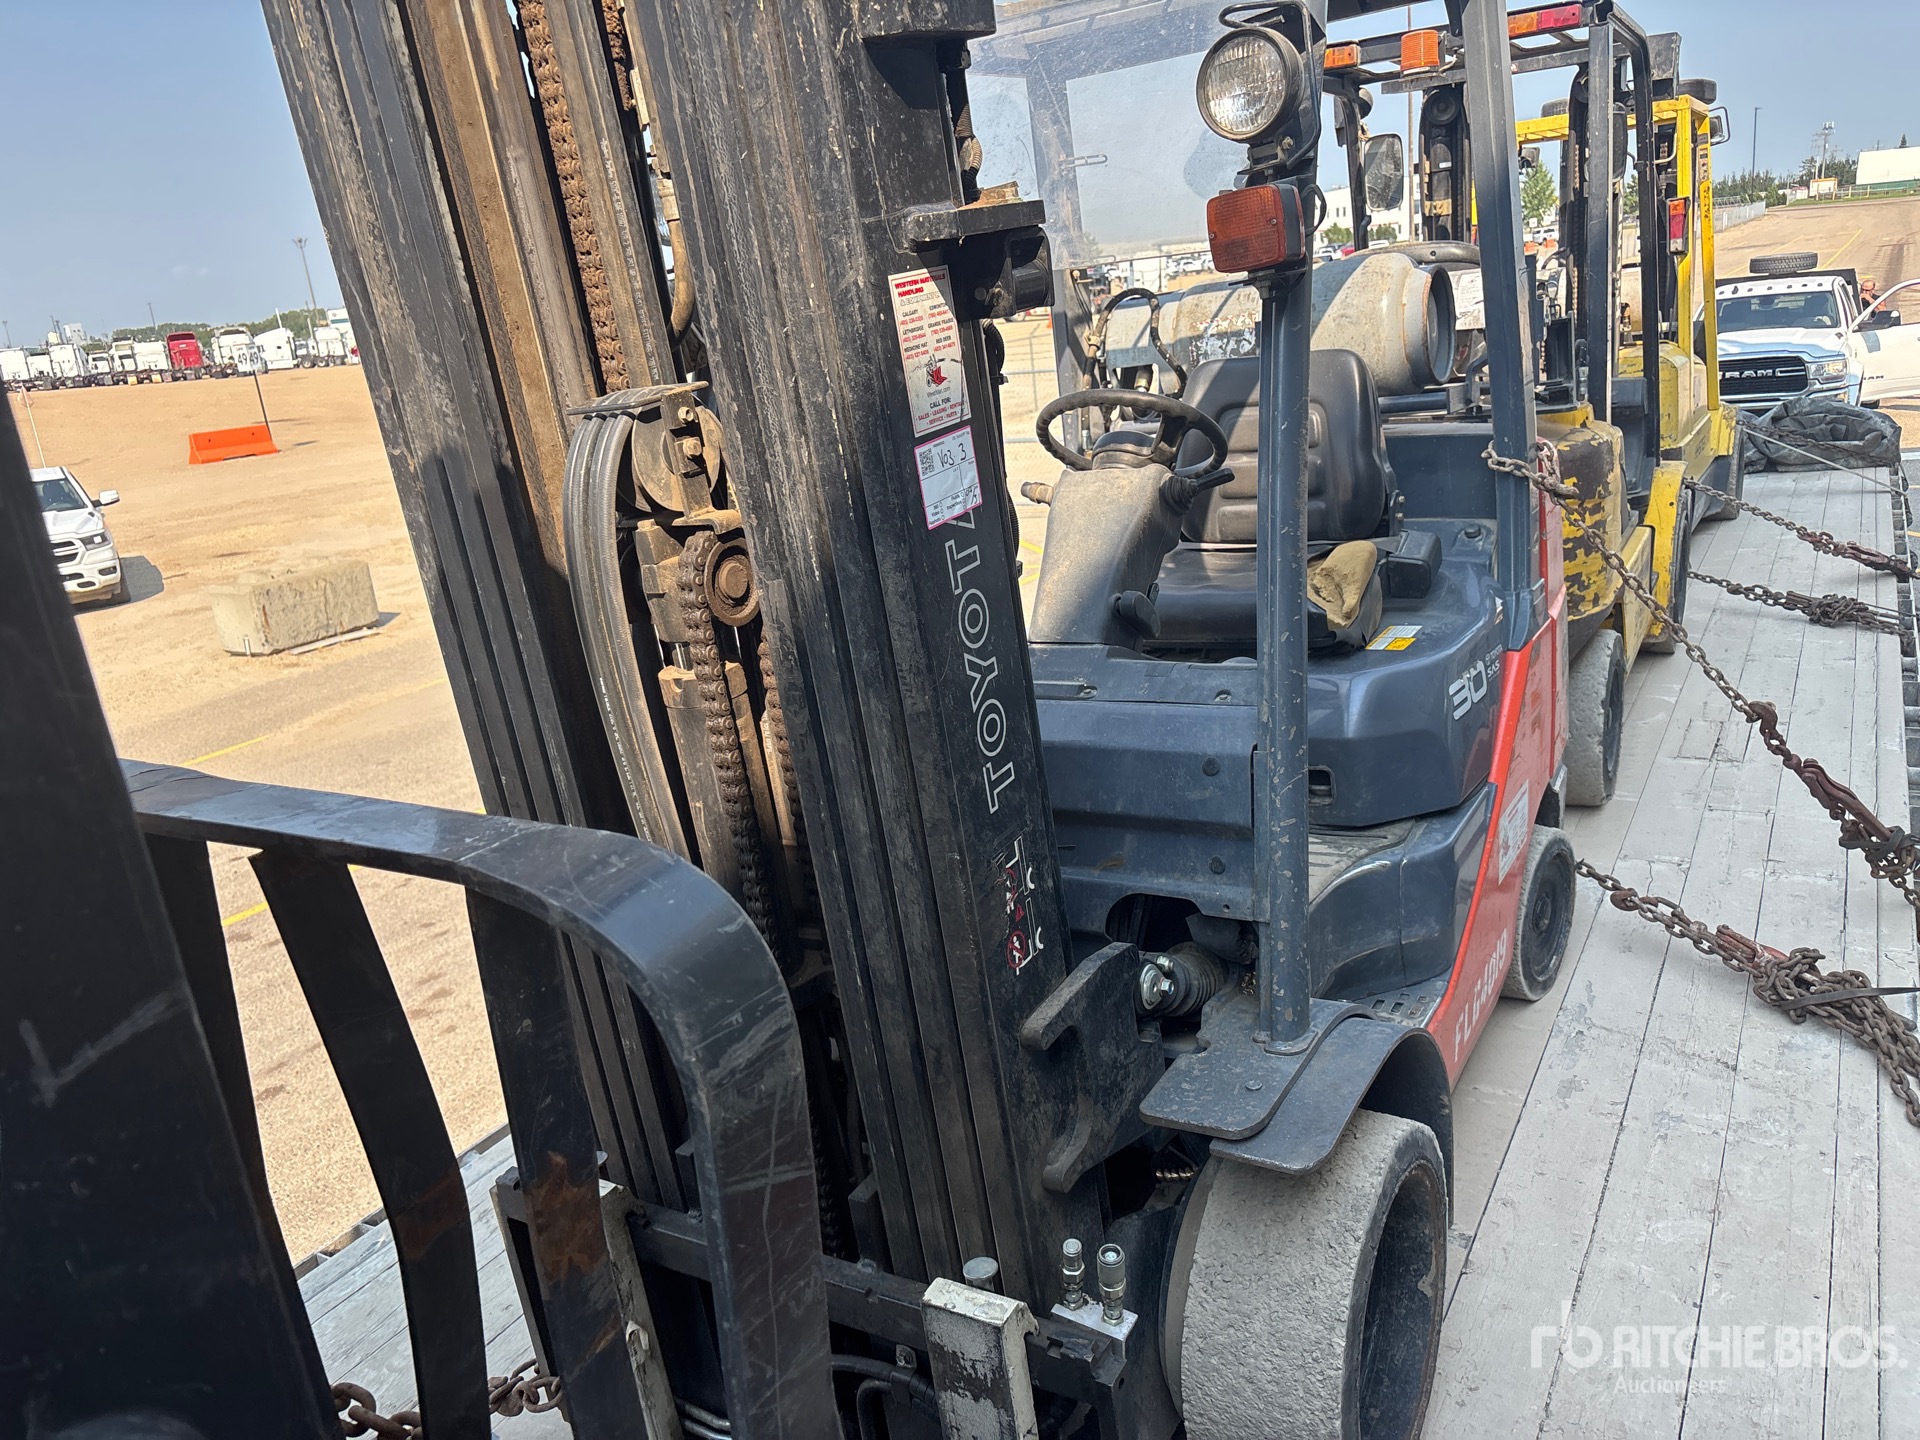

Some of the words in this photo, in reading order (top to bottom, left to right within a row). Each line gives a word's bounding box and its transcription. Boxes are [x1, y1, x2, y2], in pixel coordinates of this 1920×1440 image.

[895, 279, 919, 290] WESTERN
[902, 309, 918, 317] CALGARY
[238, 352, 247, 366] 49
[1725, 369, 1773, 379] RAM
[930, 401, 941, 409] CALL
[1487, 660, 1500, 678] SAS
[1449, 660, 1488, 720] 30
